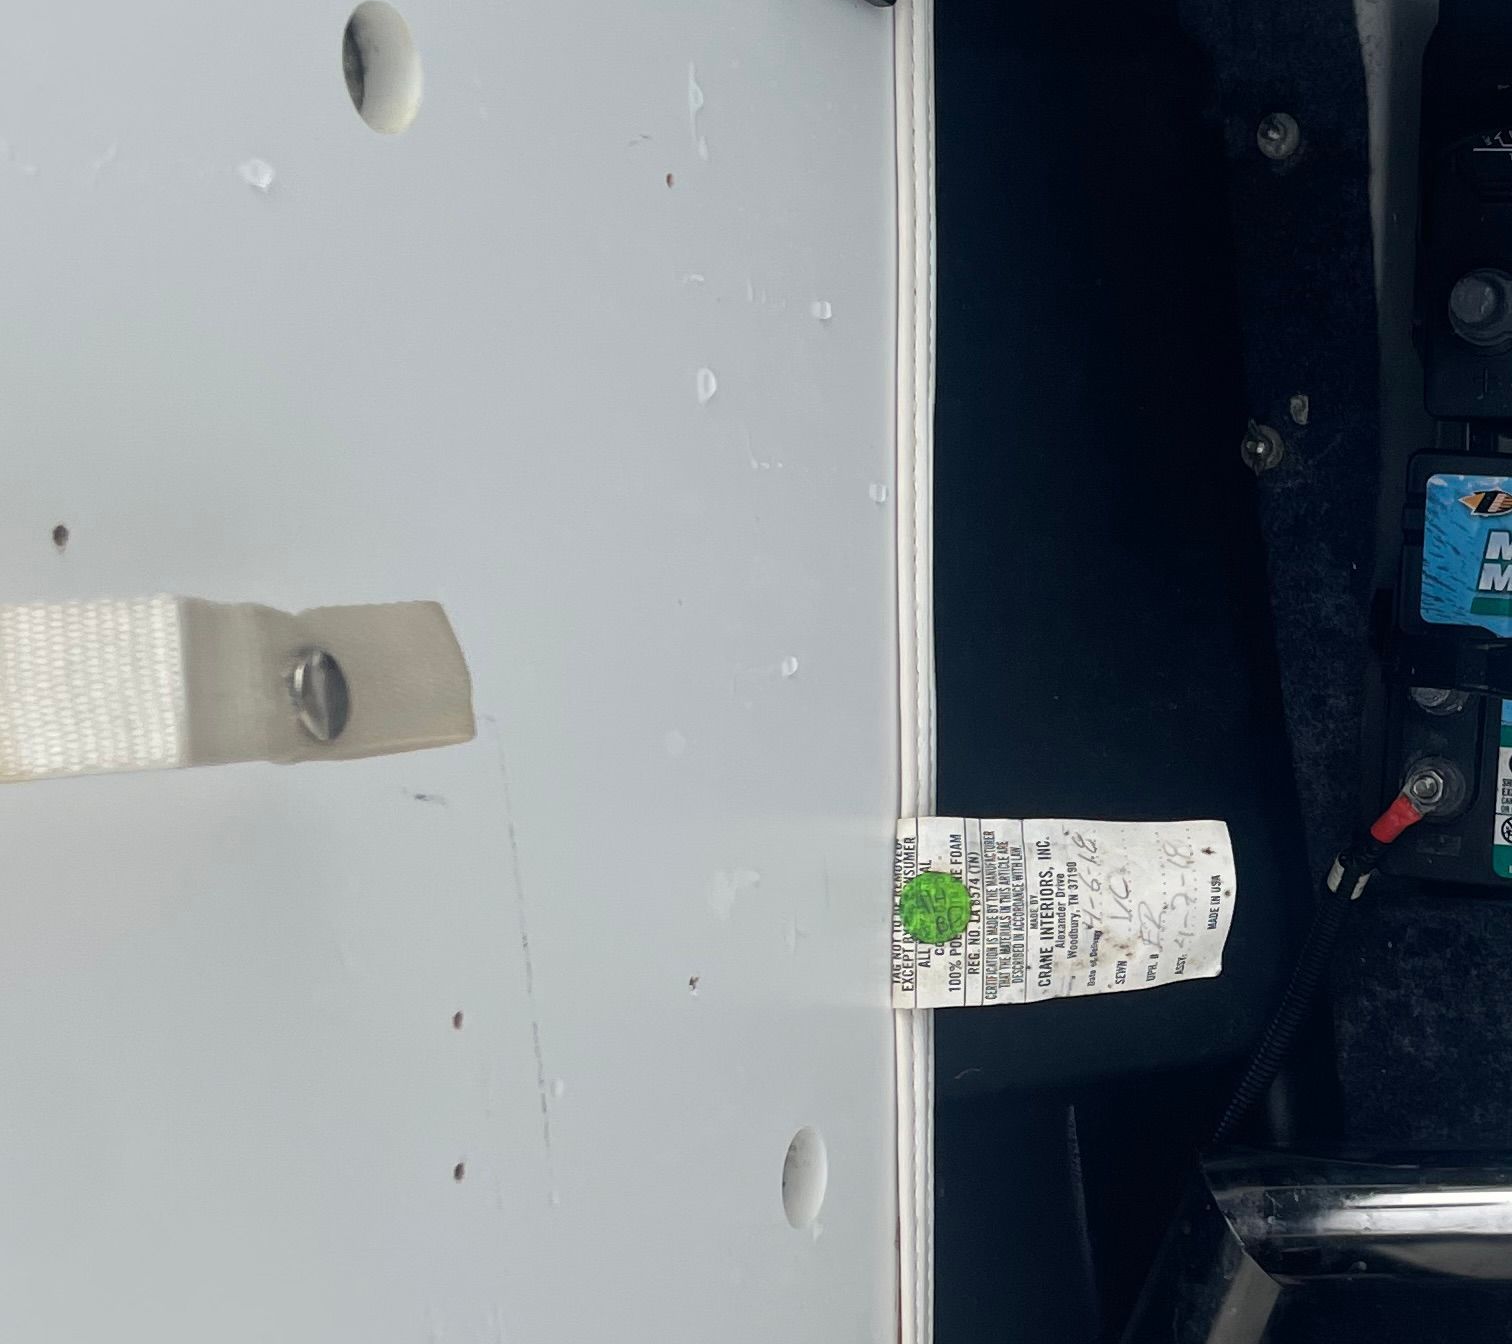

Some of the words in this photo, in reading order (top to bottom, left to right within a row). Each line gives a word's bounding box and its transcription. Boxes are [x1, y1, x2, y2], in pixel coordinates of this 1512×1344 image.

[950, 834, 963, 864] FOAM
[983, 831, 998, 886] MANUFACTURER
[996, 841, 1009, 854] ARE
[1036, 836, 1052, 860] INC.
[968, 852, 981, 874] (TN)
[998, 856, 1011, 885] ARTICLE
[1011, 862, 1024, 881] WITH
[1055, 873, 1067, 898] Drive
[1067, 861, 1079, 890] 37190
[1209, 874, 1221, 893] USA
[985, 888, 998, 902] THE
[999, 887, 1011, 903] THIS
[1029, 894, 1039, 905] BY
[1039, 866, 1055, 941] INTERIORS,
[1068, 894, 1079, 906] TN
[1209, 895, 1220, 905] IN
[986, 904, 998, 913] BY
[999, 905, 1011, 913] IN
[1012, 883, 1025, 931] ACCORDANCE
[986, 915, 998, 935] MADE
[1029, 908, 1039, 929] MADE
[1055, 902, 1067, 948] Alexander
[1207, 907, 1219, 930] MADE
[968, 926, 981, 945] NO.
[999, 915, 1011, 954] MATERIALS
[1013, 933, 1025, 941] IN
[1066, 910, 1081, 959] Woodbury,
[918, 948, 931, 967] ALL
[968, 948, 980, 974] REG.
[999, 956, 1011, 970] THE
[1012, 943, 1025, 983] DESCRIBED
[1037, 945, 1053, 987] CRANE
[902, 948, 915, 991] EXCEPT
[949, 960, 962, 992] 100%
[984, 947, 998, 1000] CERTIFICATION
[998, 972, 1011, 988] THAT
[1086, 969, 1097, 986] Date
[1115, 960, 1127, 984] SEWN
